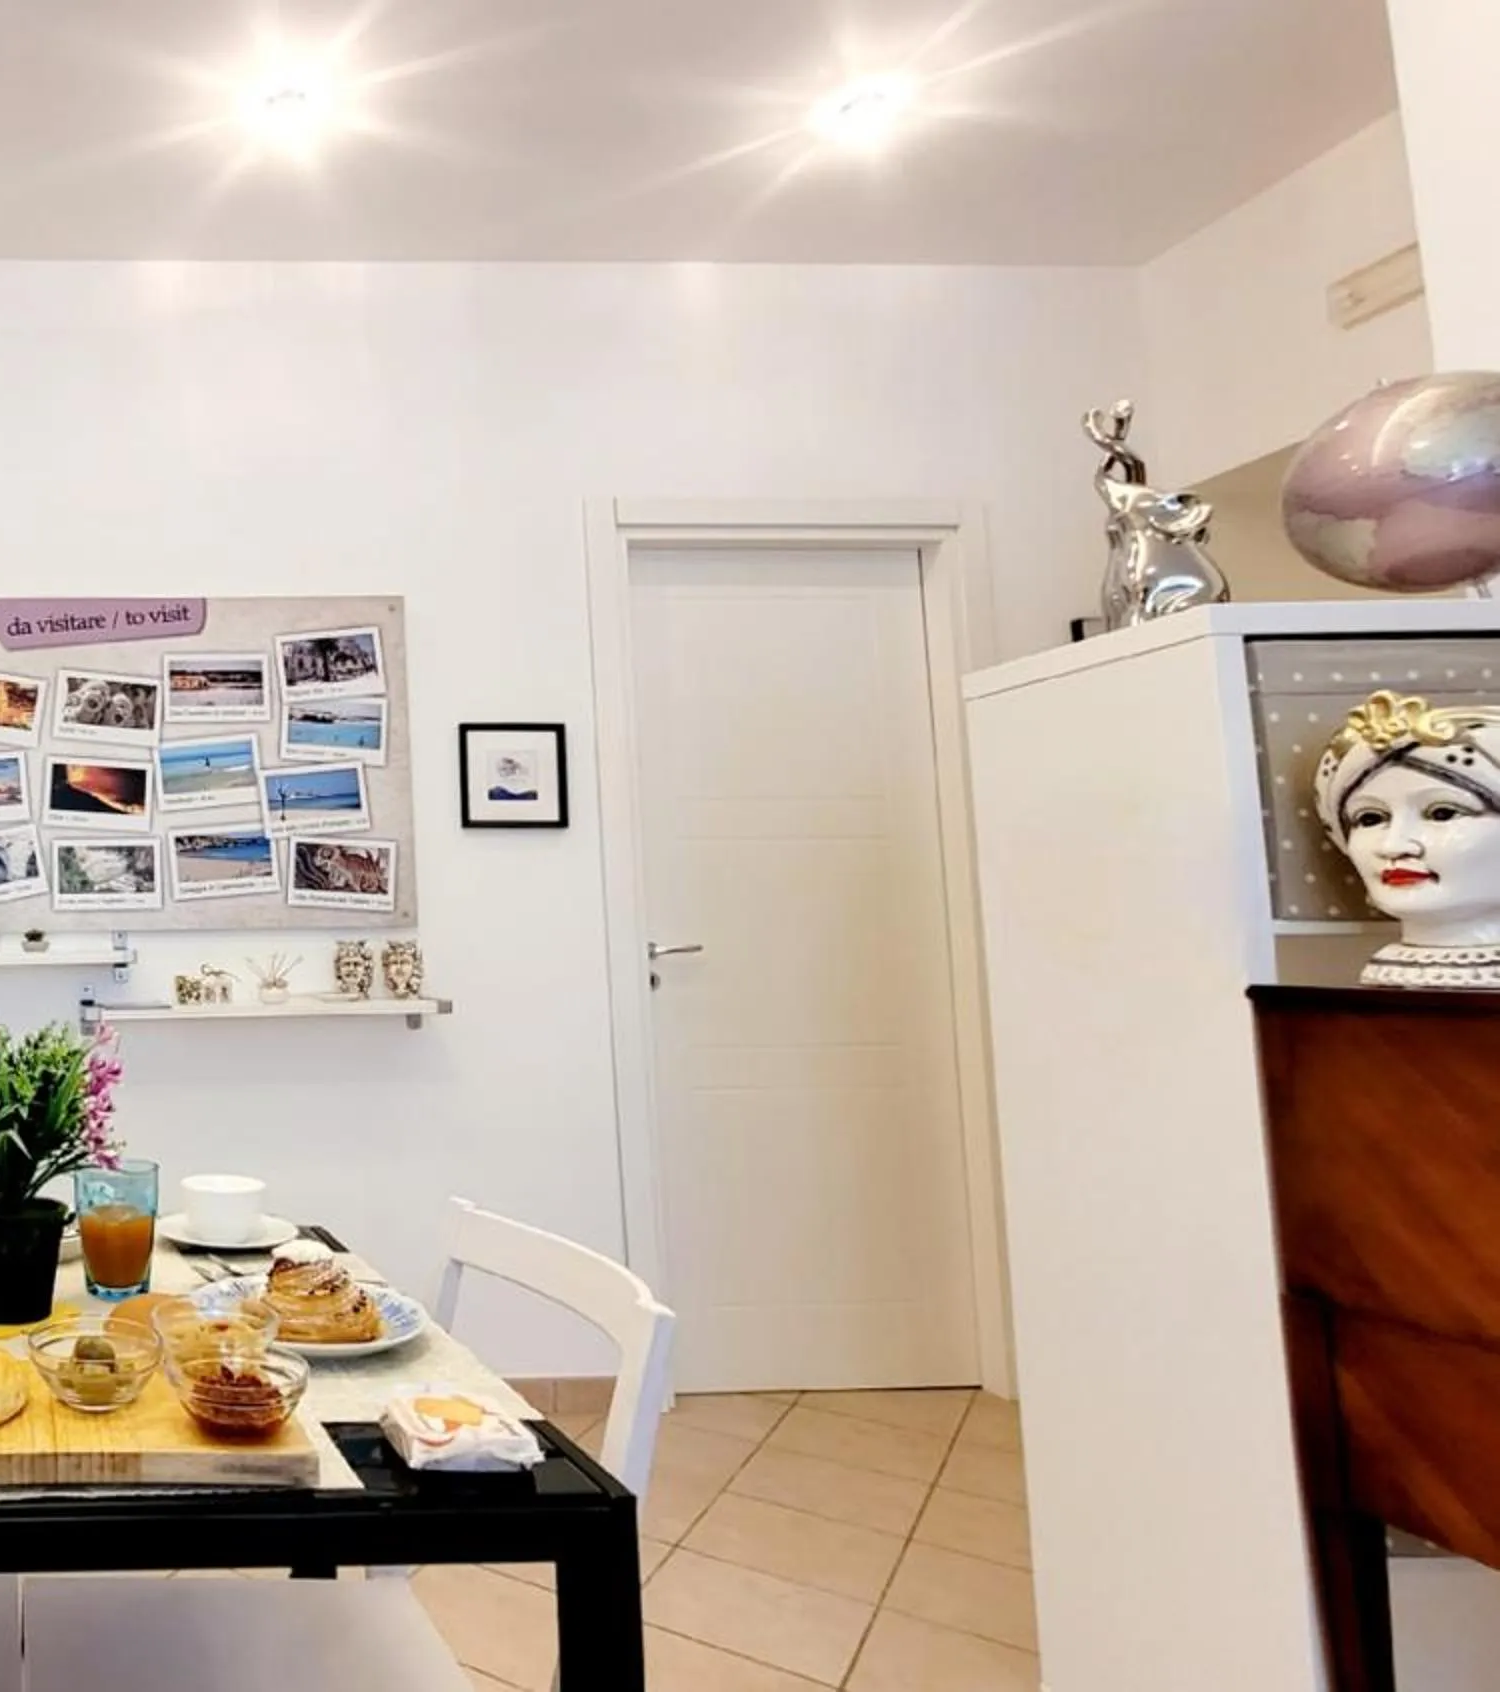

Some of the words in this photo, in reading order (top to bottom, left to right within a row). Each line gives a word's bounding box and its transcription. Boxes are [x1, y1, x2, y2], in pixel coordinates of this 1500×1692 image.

[6, 616, 33, 637] da
[36, 612, 107, 634] visitare
[125, 609, 146, 626] to
[147, 603, 192, 624] visit
